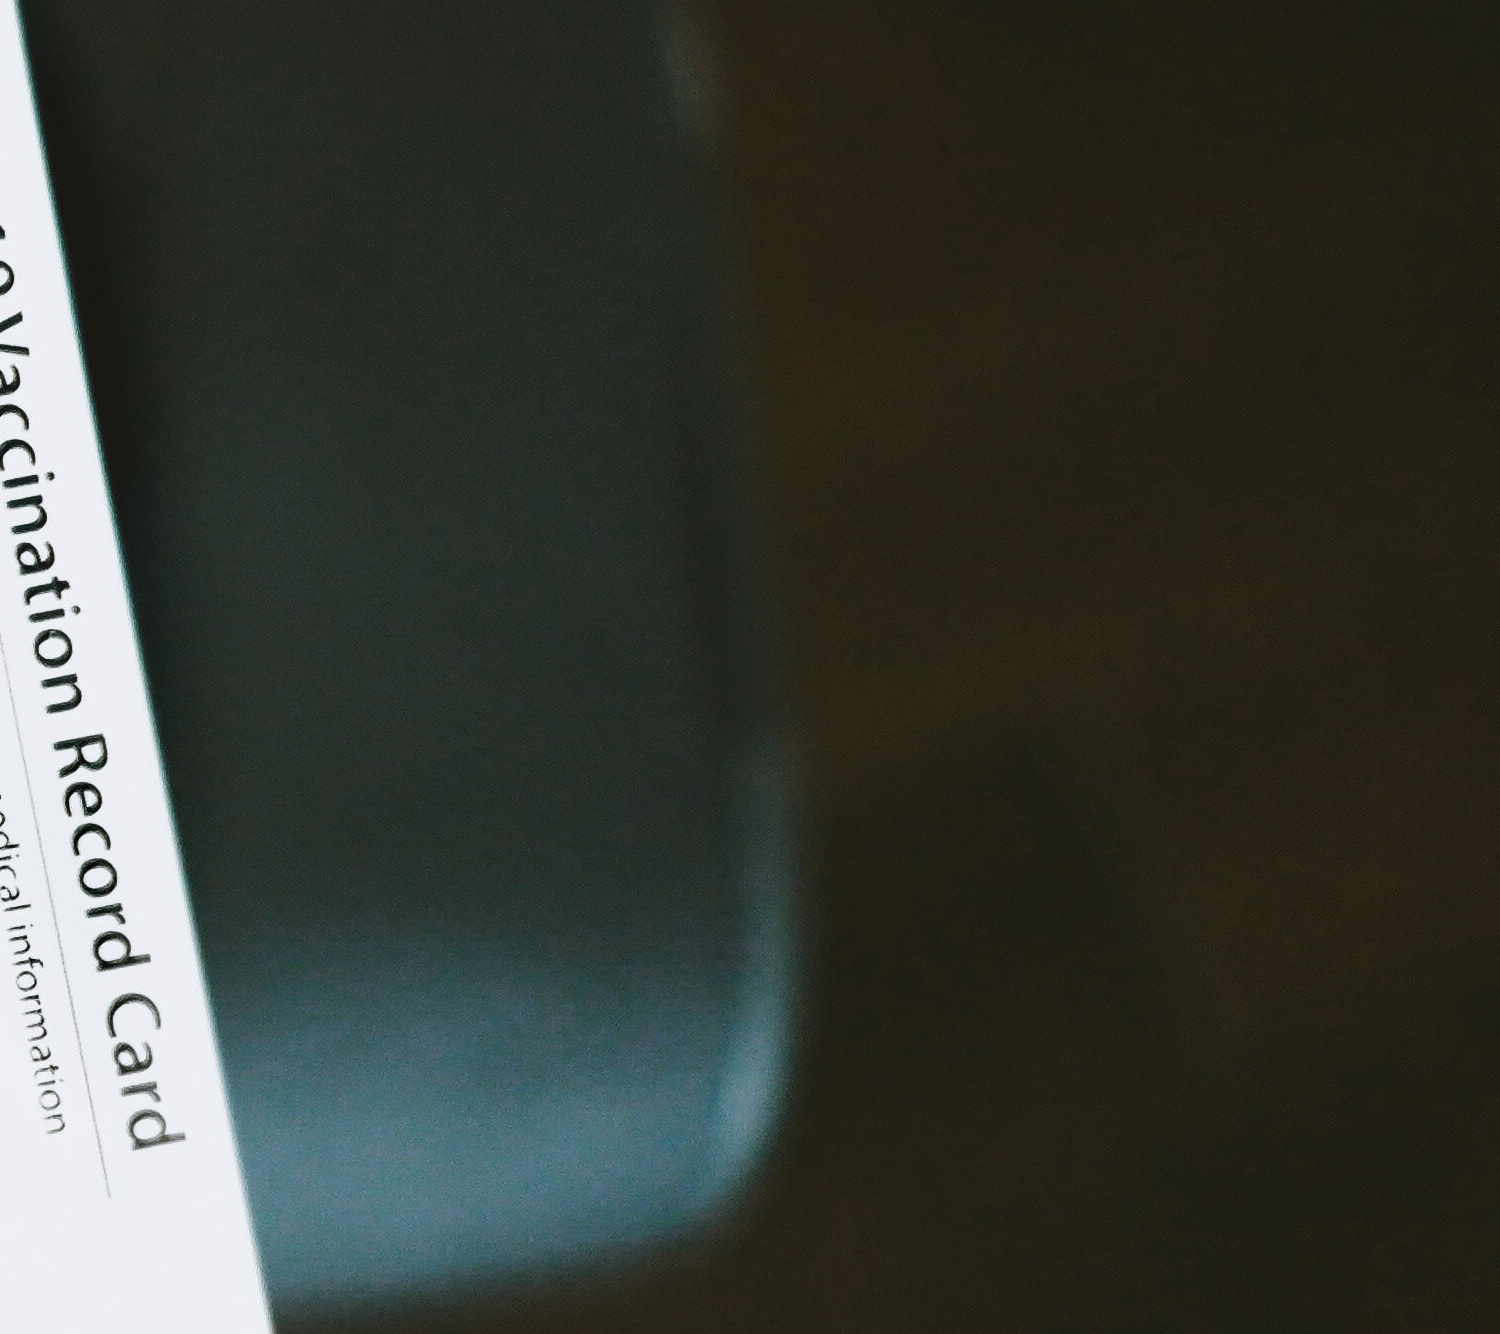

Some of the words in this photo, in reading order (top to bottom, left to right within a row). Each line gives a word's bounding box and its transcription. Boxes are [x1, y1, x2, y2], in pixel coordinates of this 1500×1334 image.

[6, 923, 67, 1135] information
[51, 732, 152, 974] Record
[105, 991, 187, 1152] Card
